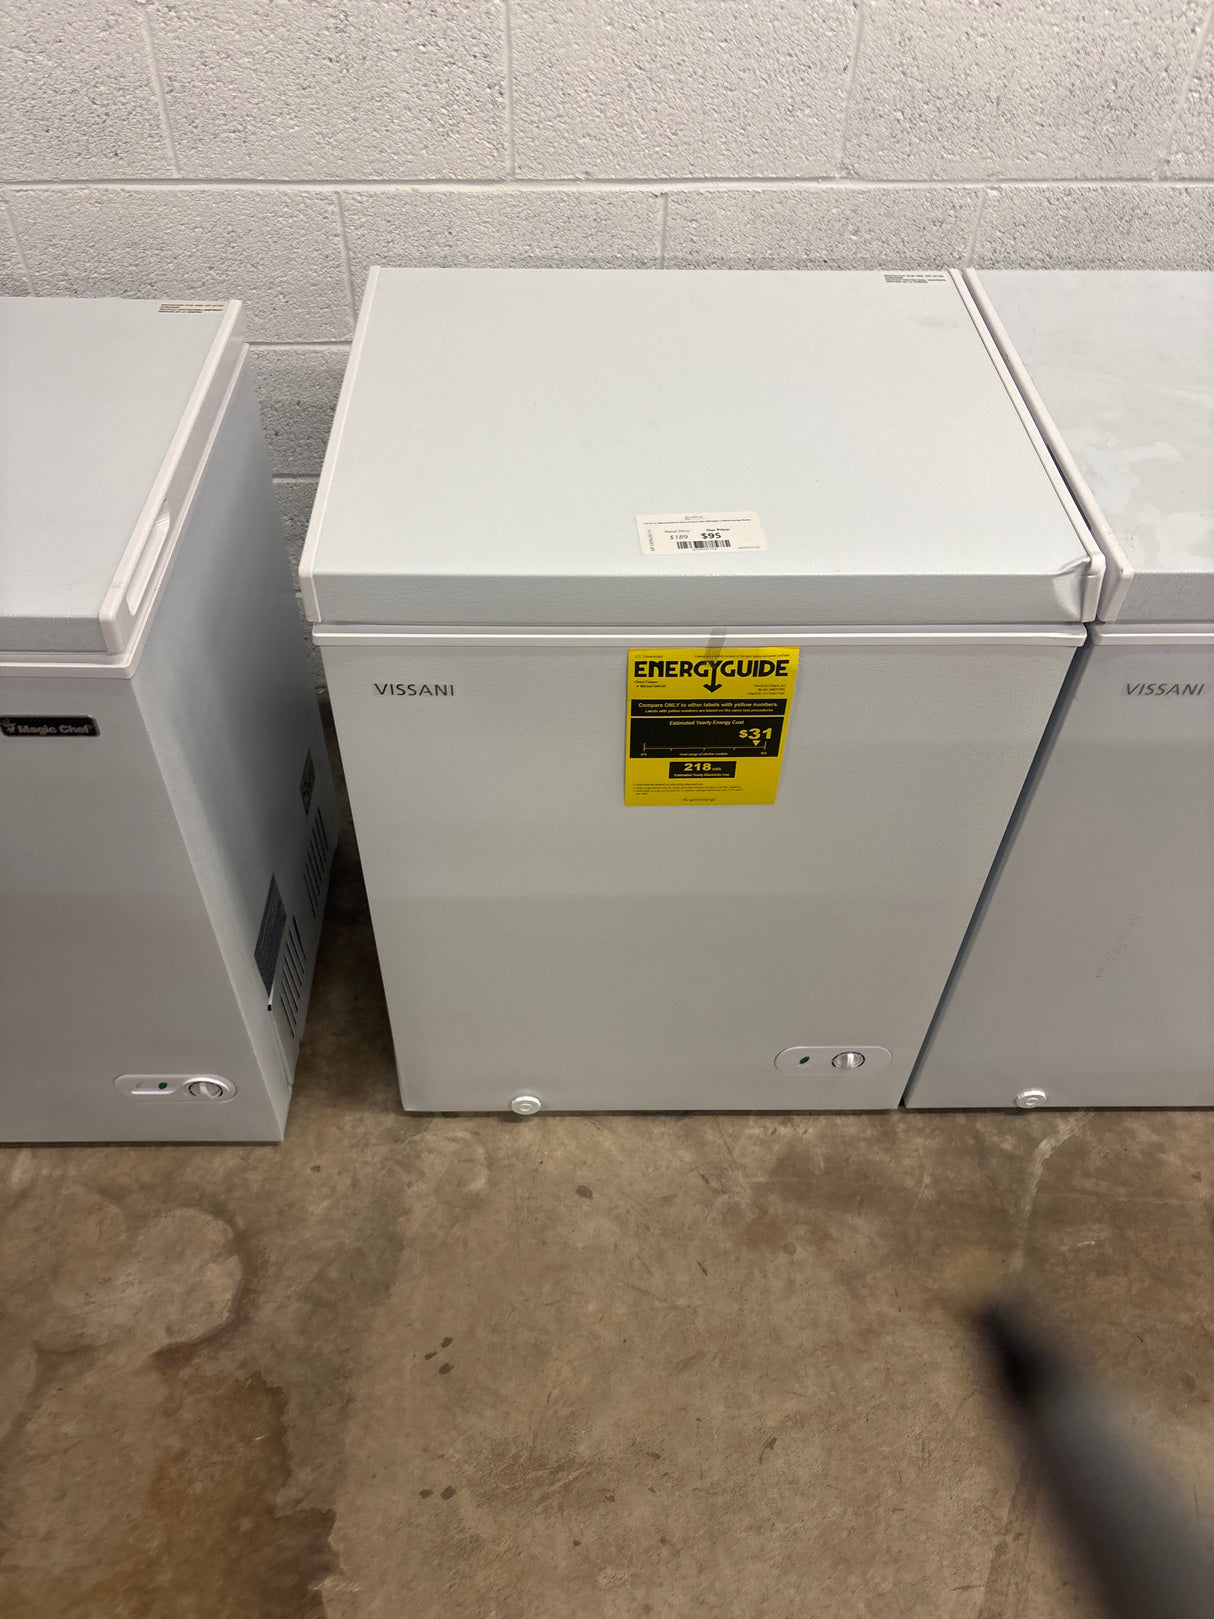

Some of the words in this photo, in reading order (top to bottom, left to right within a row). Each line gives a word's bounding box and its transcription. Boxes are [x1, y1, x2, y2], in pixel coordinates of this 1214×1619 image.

[634, 660, 790, 679] ENERGYGUIDE
[374, 683, 454, 696] VISSANI
[1127, 683, 1205, 696] VISSANI
[17, 725, 57, 735] Magic
[59, 724, 89, 734] Chef
[738, 727, 773, 740] $31
[683, 763, 712, 771] 218
